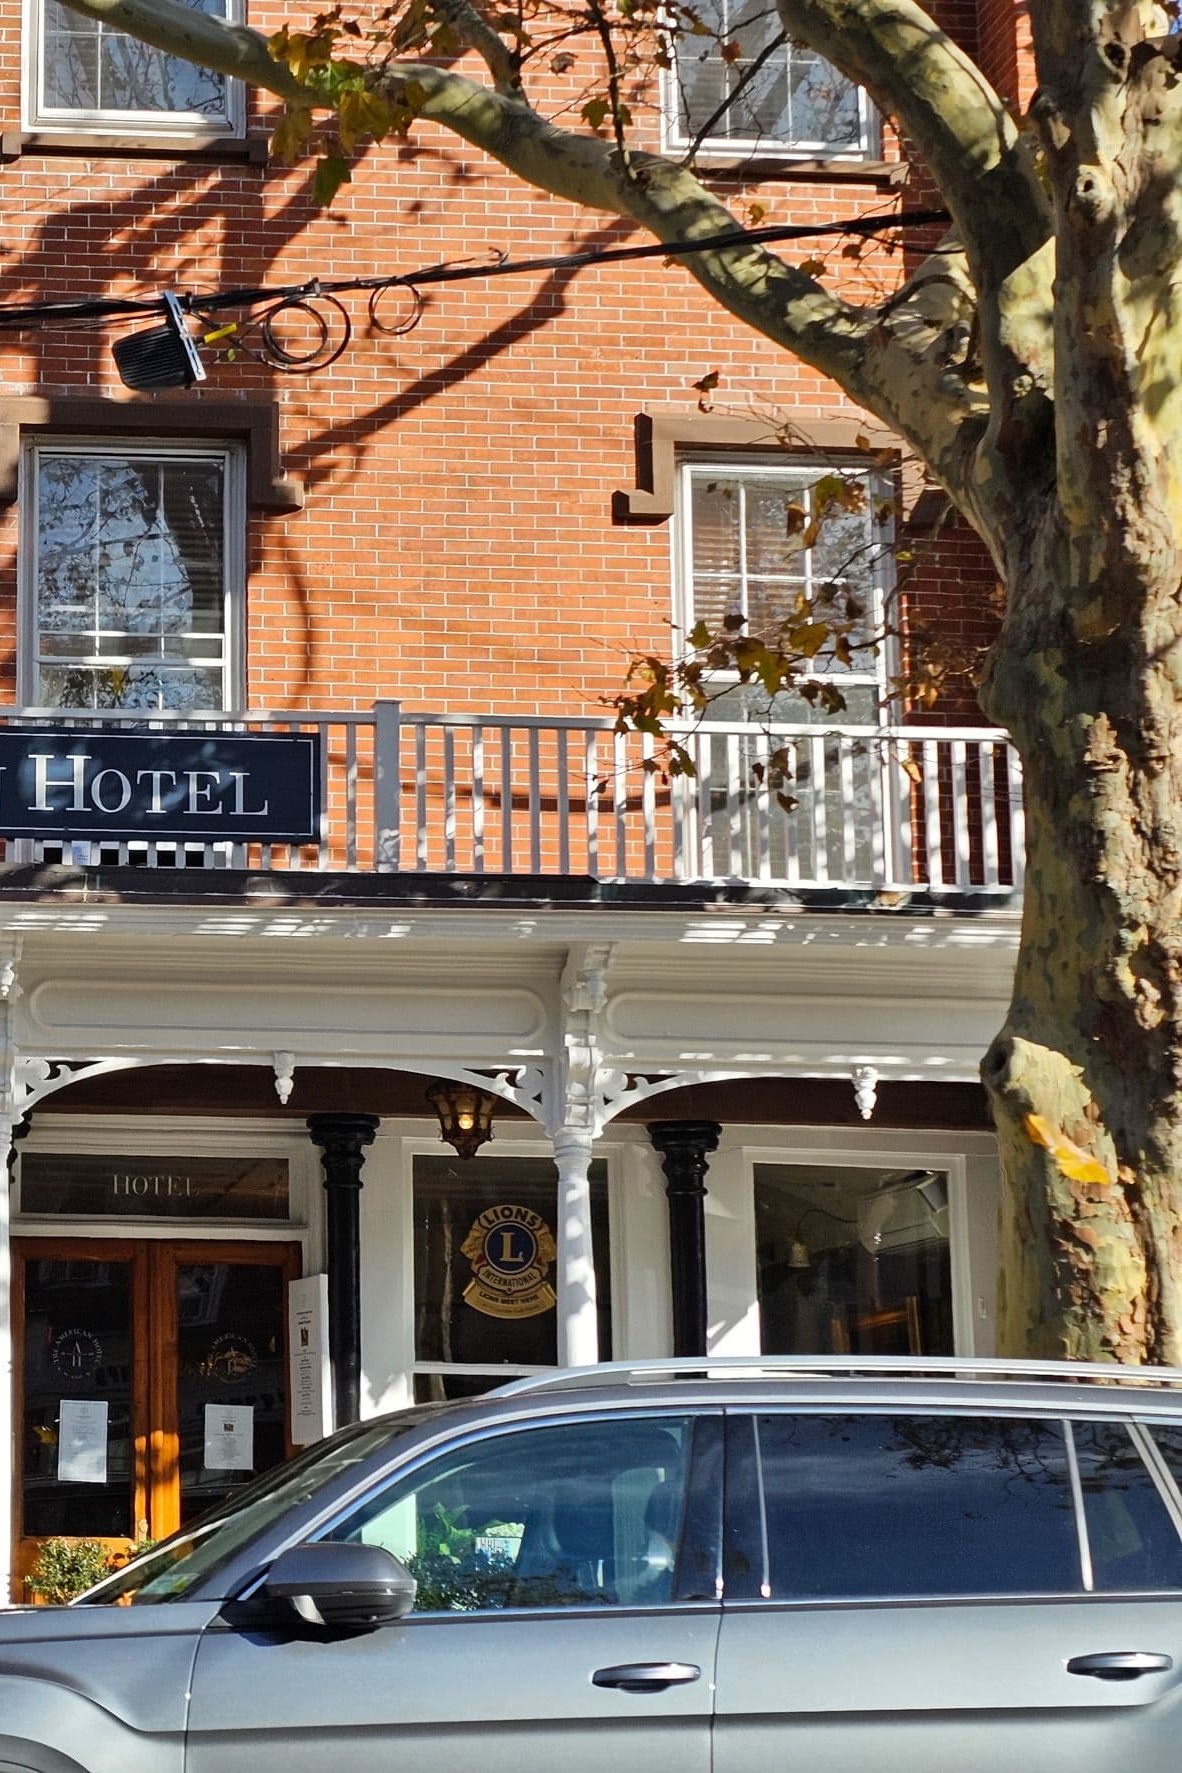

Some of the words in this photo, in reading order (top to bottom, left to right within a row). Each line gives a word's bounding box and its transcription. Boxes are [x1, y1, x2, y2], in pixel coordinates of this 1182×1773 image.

[27, 754, 269, 815] HOTEL
[113, 1175, 200, 1197] HOTEL
[483, 1206, 539, 1227] LIONS
[498, 1232, 524, 1262] L
